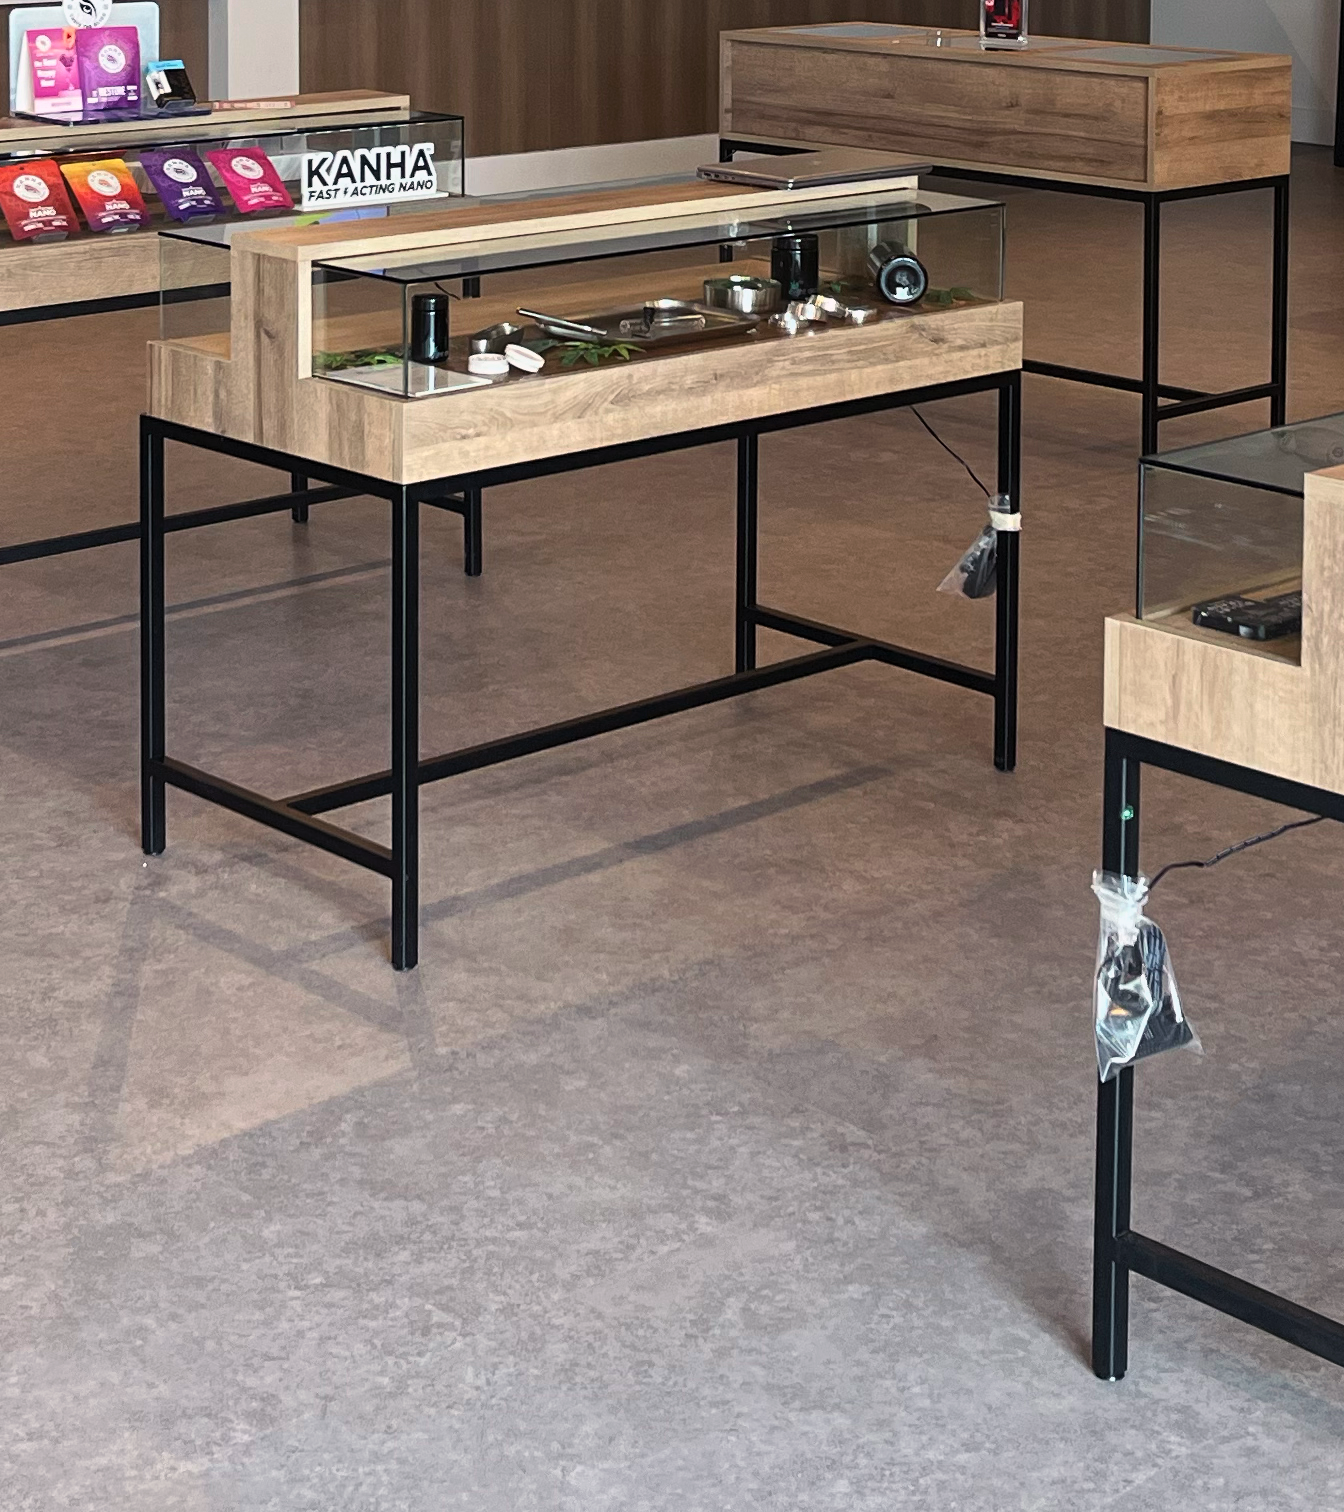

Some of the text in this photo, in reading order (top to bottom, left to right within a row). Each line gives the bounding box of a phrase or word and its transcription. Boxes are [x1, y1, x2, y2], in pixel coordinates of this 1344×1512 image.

[307, 148, 434, 189] KANHA
[308, 179, 434, 202] FAST ACTING NANO
